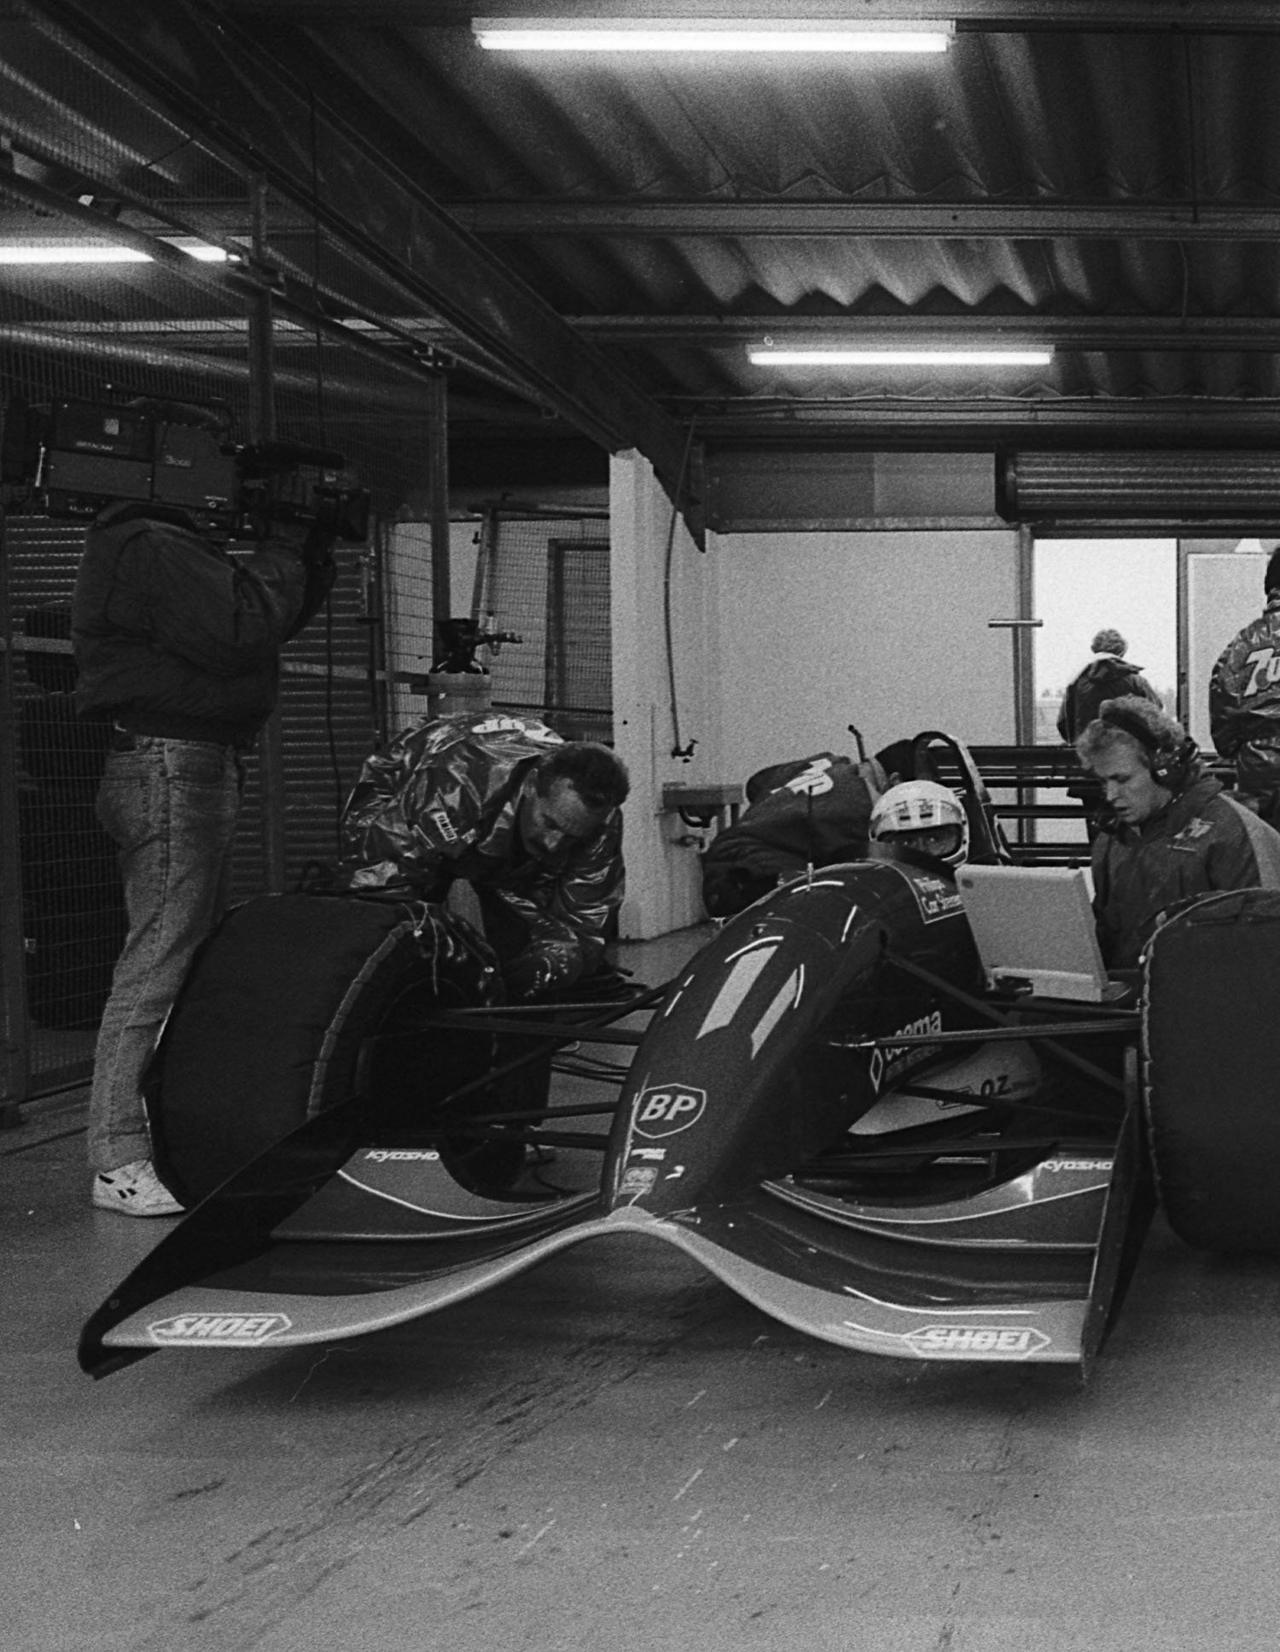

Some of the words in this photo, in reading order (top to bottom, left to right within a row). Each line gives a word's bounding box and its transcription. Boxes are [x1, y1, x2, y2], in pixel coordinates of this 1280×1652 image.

[638, 1094, 698, 1122] BP
[156, 1316, 279, 1338] SHOEI
[919, 1329, 1031, 1352] SHOEI
